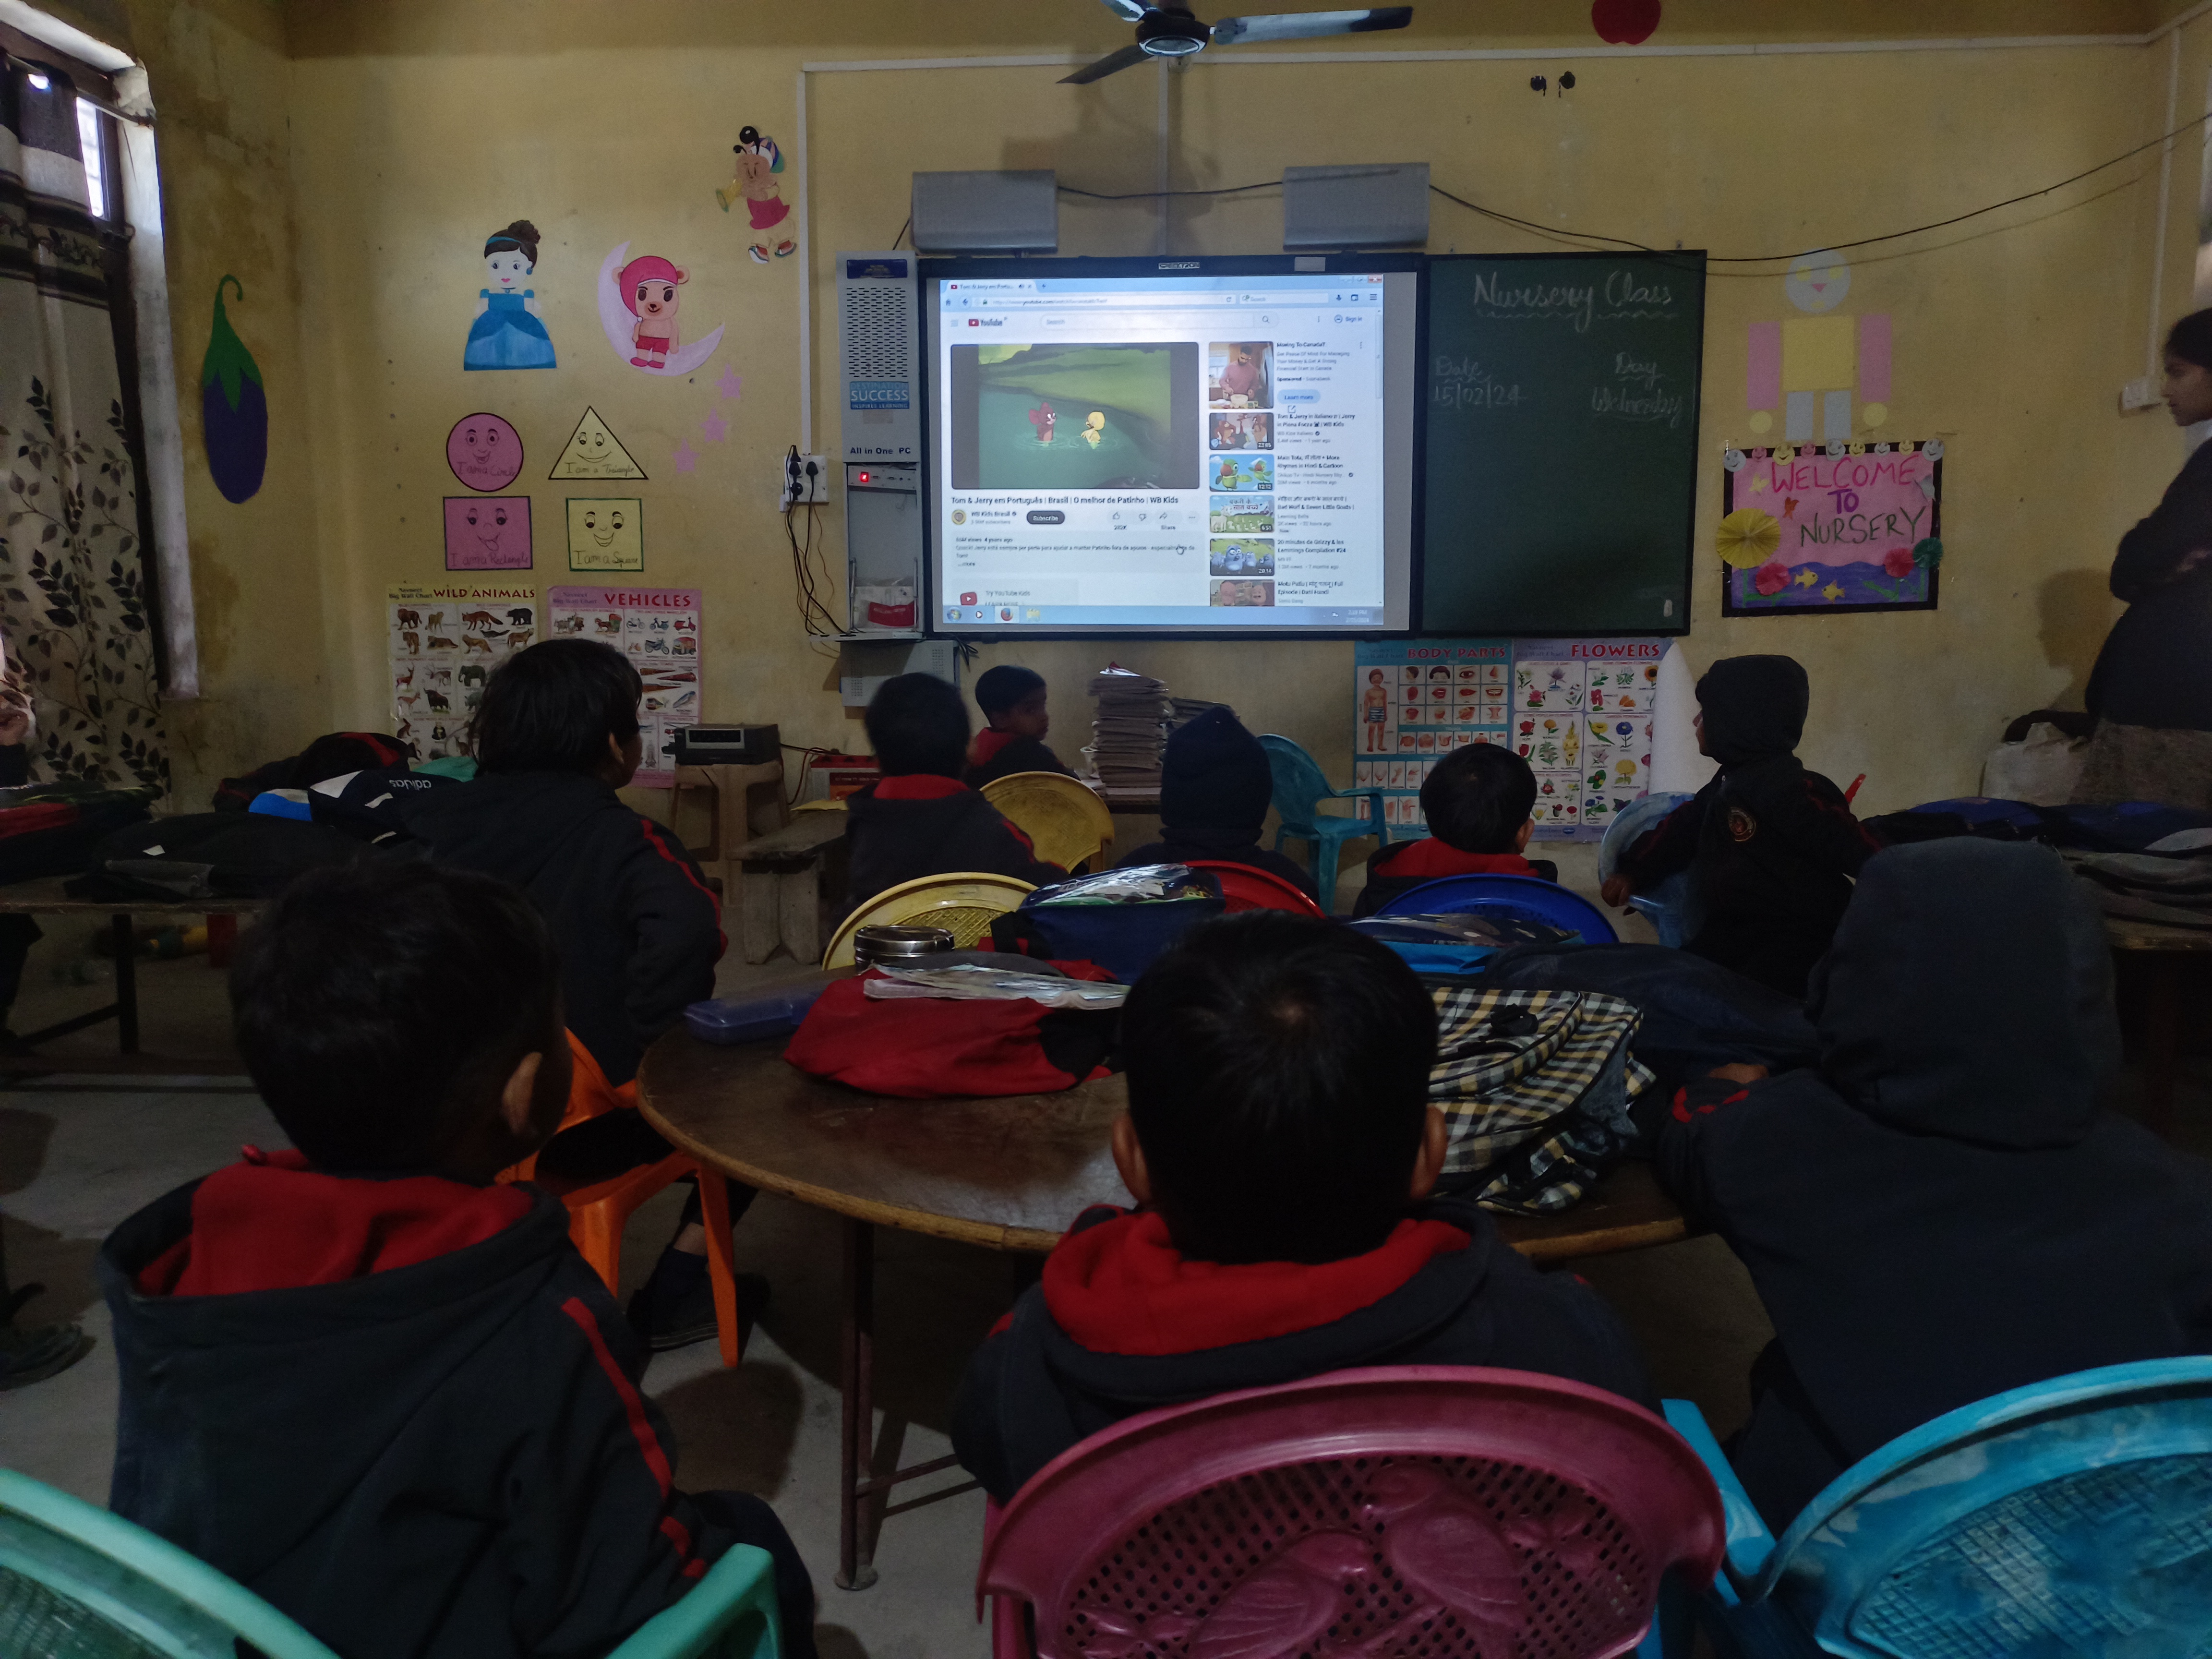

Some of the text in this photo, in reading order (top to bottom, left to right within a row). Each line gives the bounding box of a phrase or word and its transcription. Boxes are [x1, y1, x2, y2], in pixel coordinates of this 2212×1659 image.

[1474, 270, 1672, 333] Nursery Class
[1434, 355, 1483, 378] Date
[1615, 352, 1659, 388] Day
[850, 390, 908, 401] SUCCESS
[457, 462, 467, 475] I
[565, 462, 576, 474] I
[1771, 455, 1919, 493] WELCOME
[951, 496, 966, 505] Tom
[968, 496, 973, 505] &
[974, 496, 993, 505] Jerry
[994, 496, 1006, 505] em
[1048, 496, 1069, 505] Brasil
[1080, 496, 1106, 505] melhor
[1106, 496, 1116, 505] de
[1118, 496, 1145, 505] Patinho
[1150, 496, 1162, 505] WB
[1163, 496, 1179, 505] Kids
[1827, 489, 1860, 514] TO
[1801, 505, 1926, 547] NURSERY
[451, 553, 460, 566] I
[573, 551, 585, 565] I
[584, 555, 601, 564] am
[433, 589, 535, 599] WILD ANIMALS
[604, 593, 691, 607] VEHICLES
[1407, 648, 1452, 659] BODY
[1457, 648, 1506, 658] PARTS
[1571, 644, 1660, 658] FLOWERS
[389, 780, 432, 791] adidas
